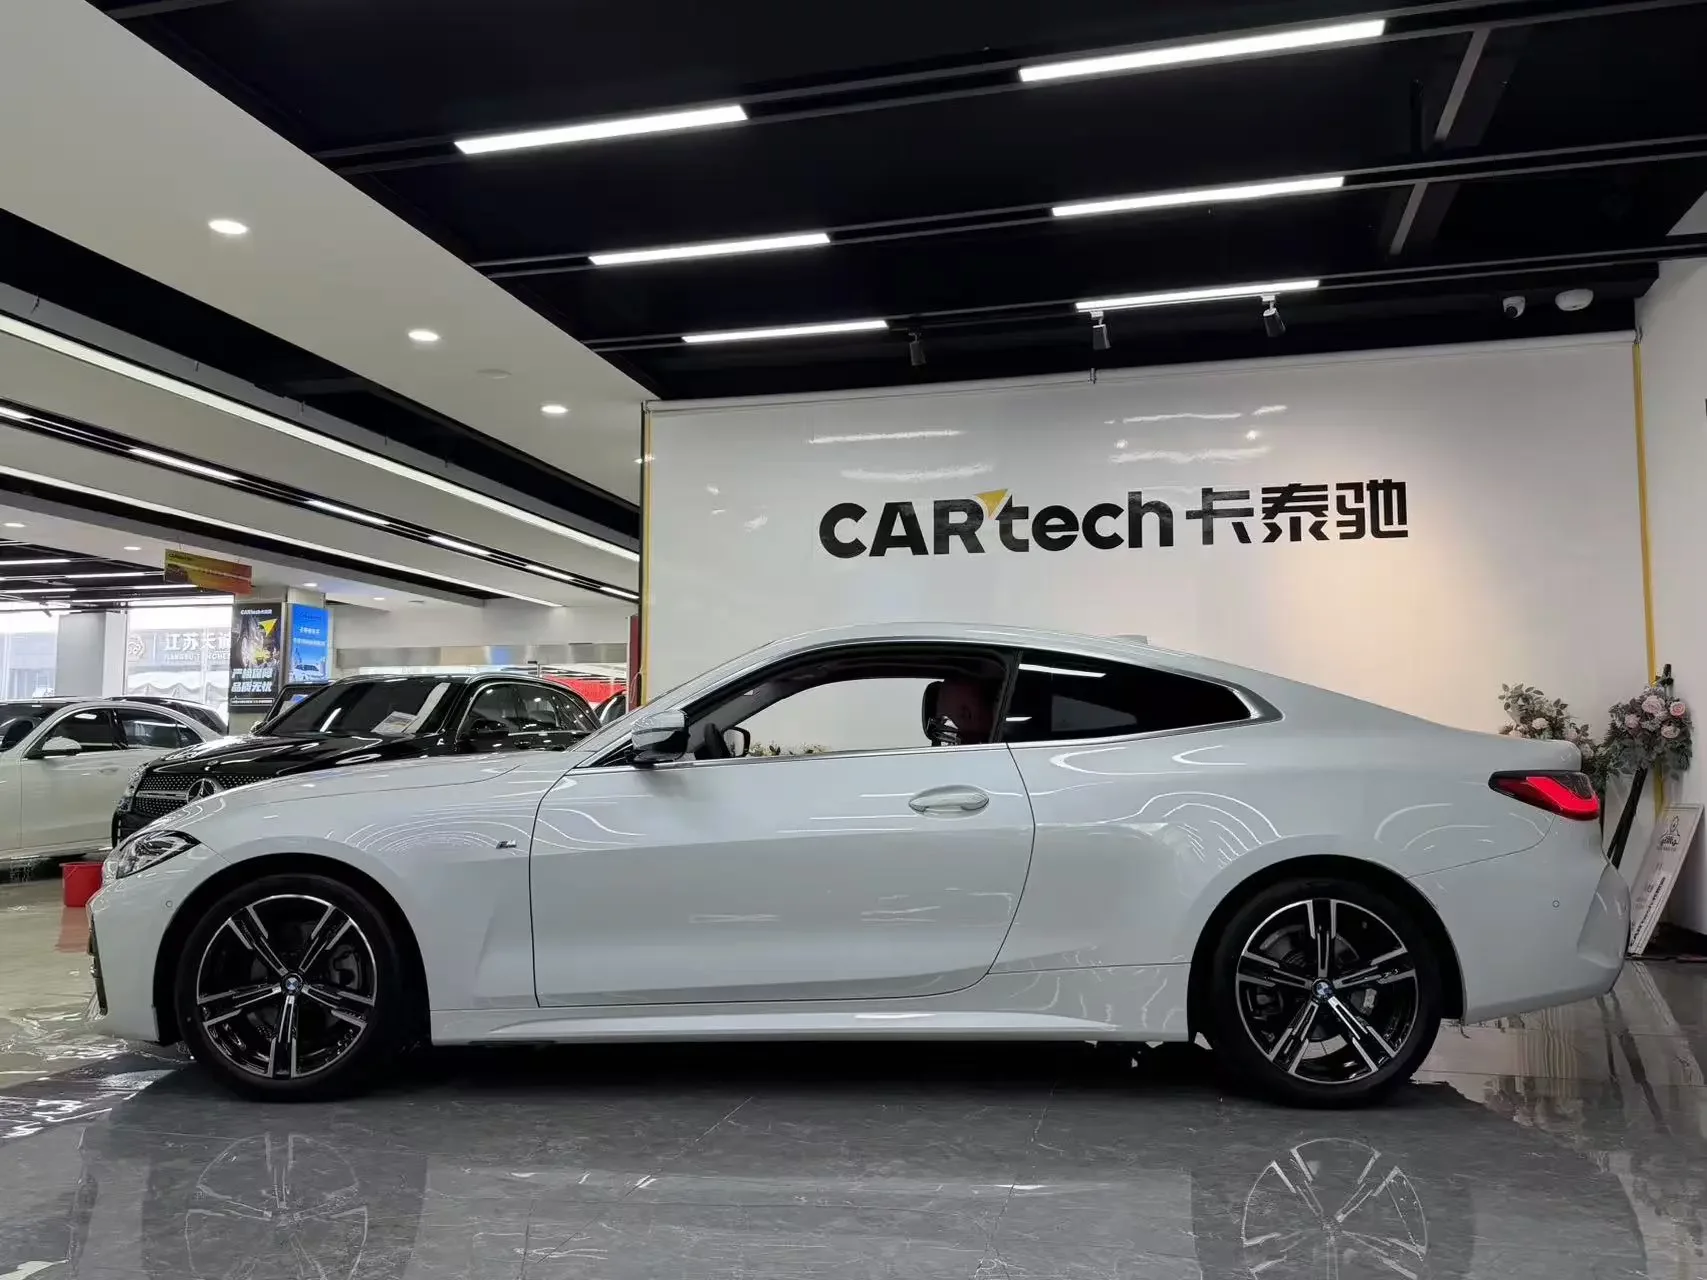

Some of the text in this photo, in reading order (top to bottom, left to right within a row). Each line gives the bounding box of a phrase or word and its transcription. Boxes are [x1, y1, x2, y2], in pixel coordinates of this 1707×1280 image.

[819, 479, 1408, 559] CARtech 卡泰驰
